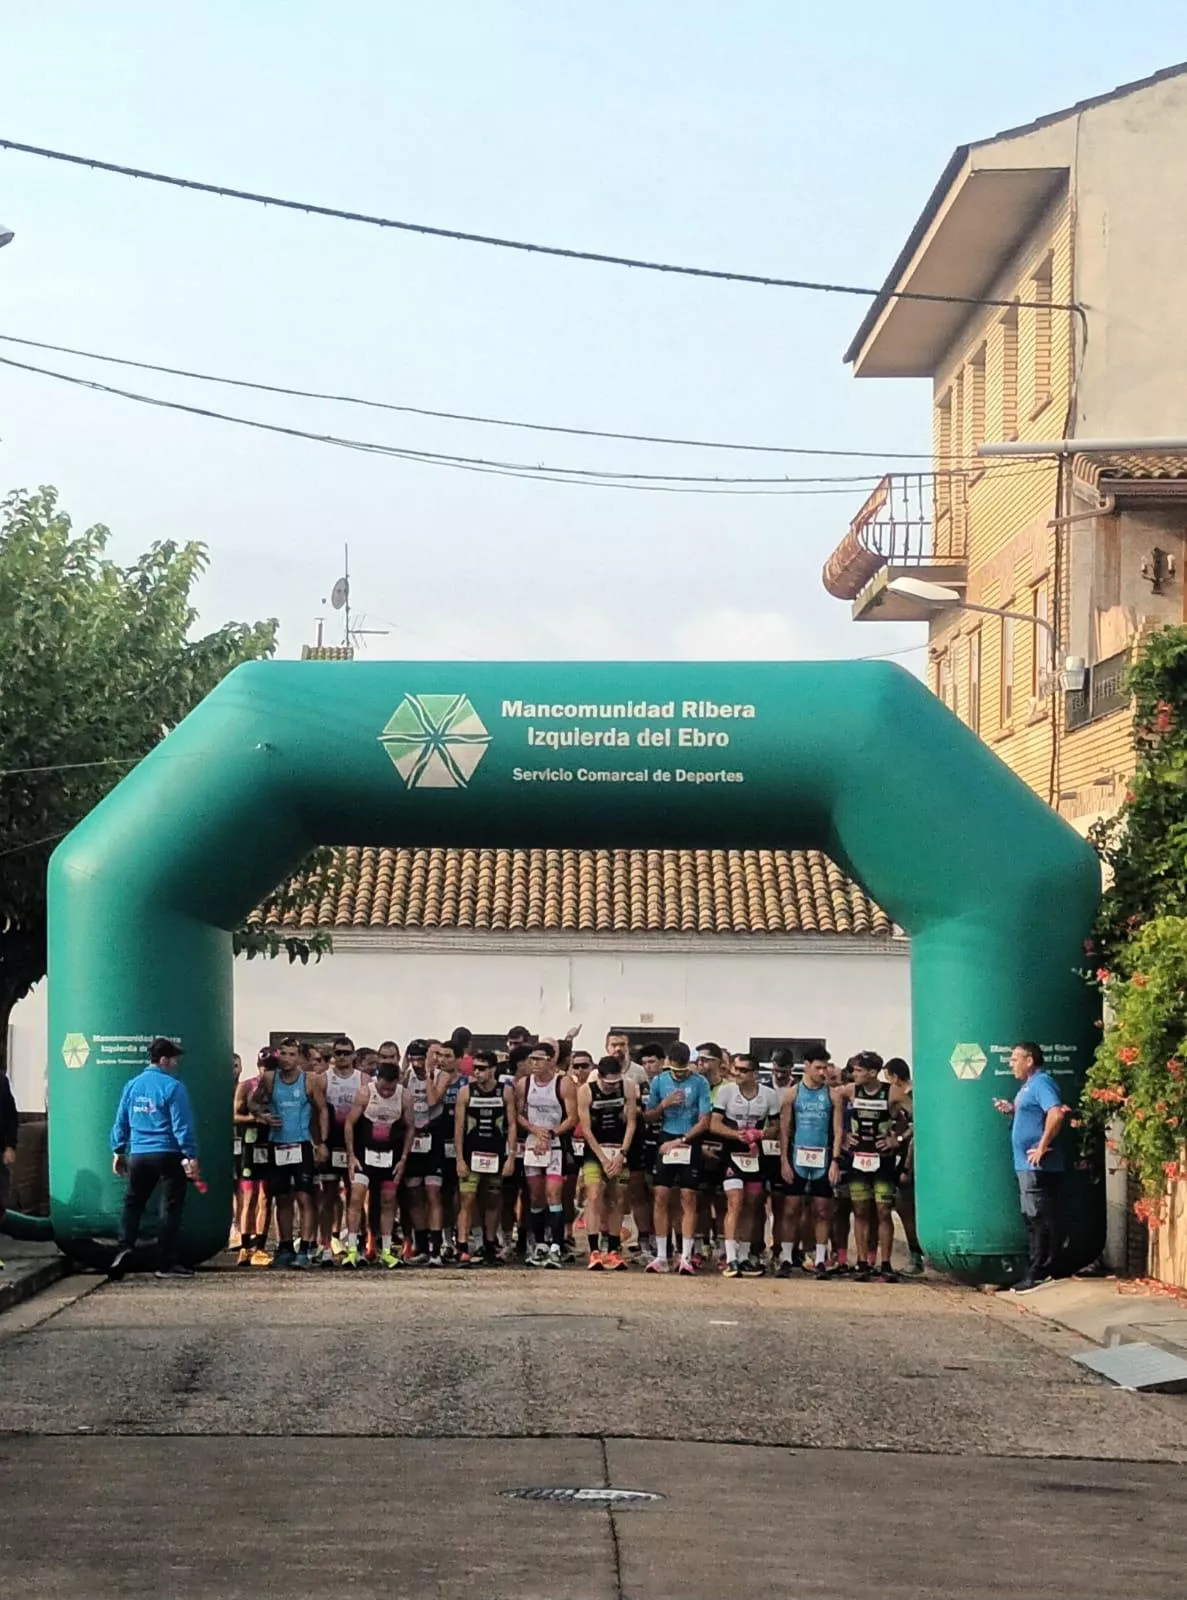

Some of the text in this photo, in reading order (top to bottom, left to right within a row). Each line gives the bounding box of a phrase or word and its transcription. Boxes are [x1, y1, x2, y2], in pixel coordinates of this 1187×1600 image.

[501, 700, 756, 719] Mancomunidad Ribera
[527, 726, 730, 750] Izquierda del Ebro
[512, 767, 745, 785] Servicio Comarcal de Deportes
